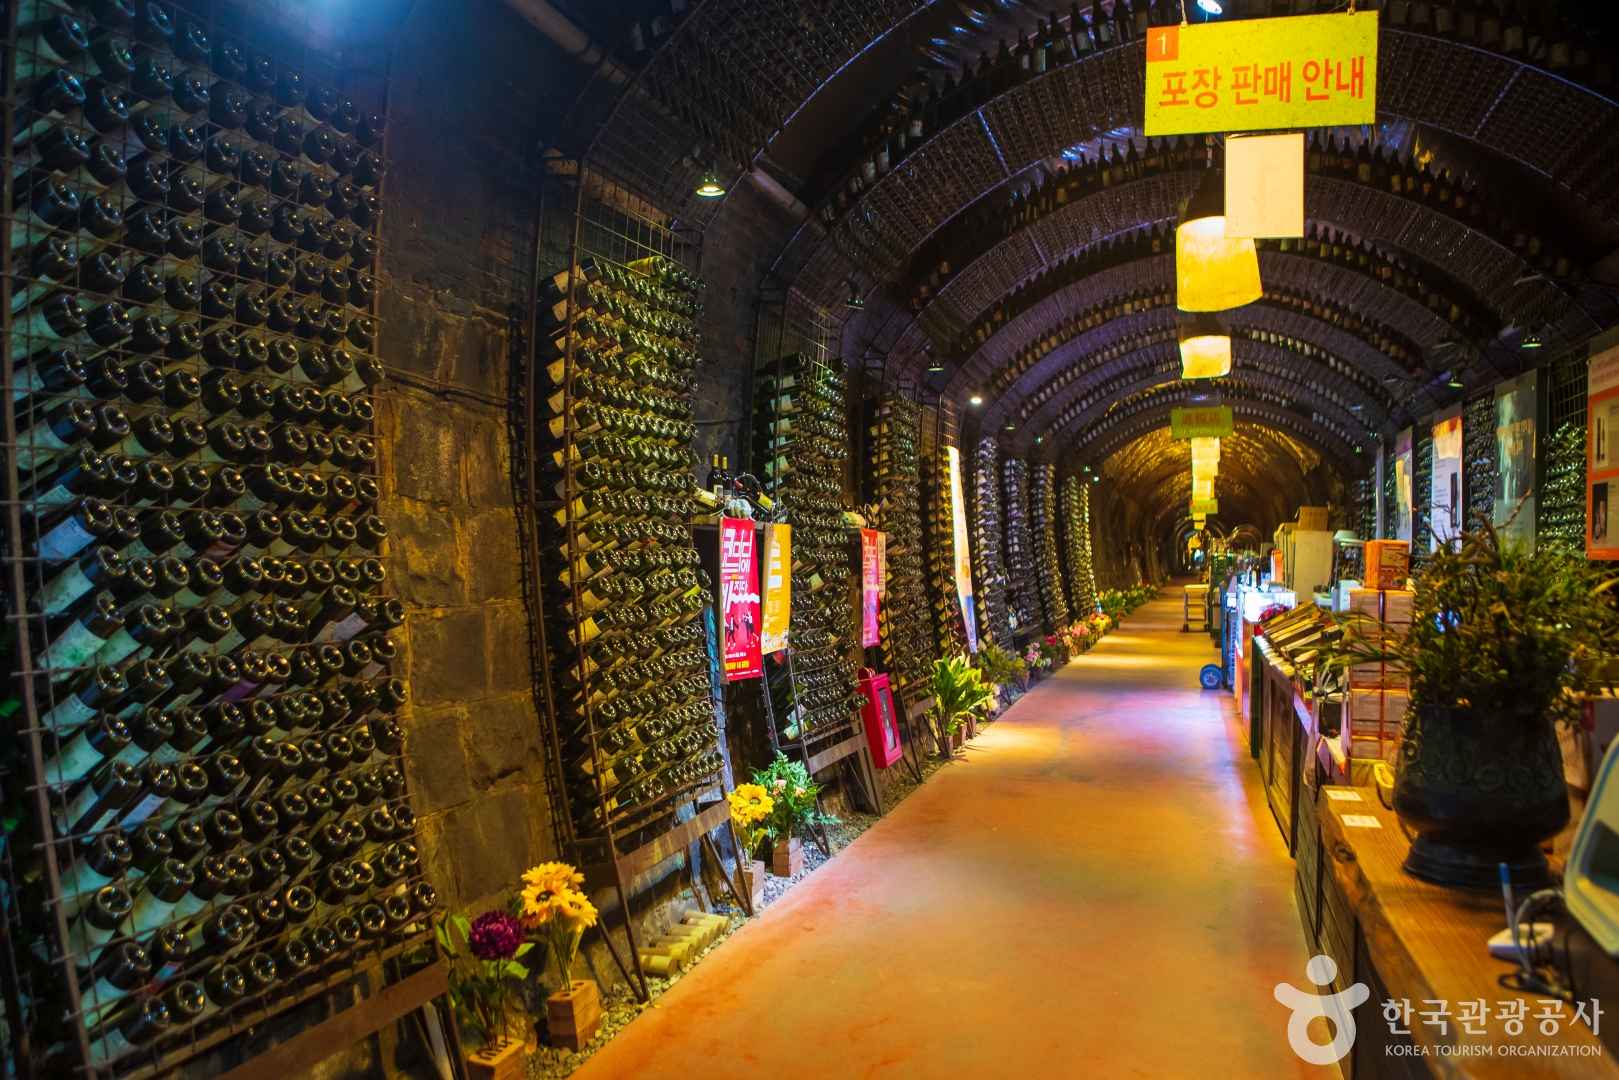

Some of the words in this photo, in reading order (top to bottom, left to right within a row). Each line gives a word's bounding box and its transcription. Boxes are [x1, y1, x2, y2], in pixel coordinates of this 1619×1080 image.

[1157, 31, 1168, 55] 1
[1159, 65, 1222, 109] 포장
[1231, 60, 1292, 105] 판매
[1302, 55, 1365, 102] 안내
